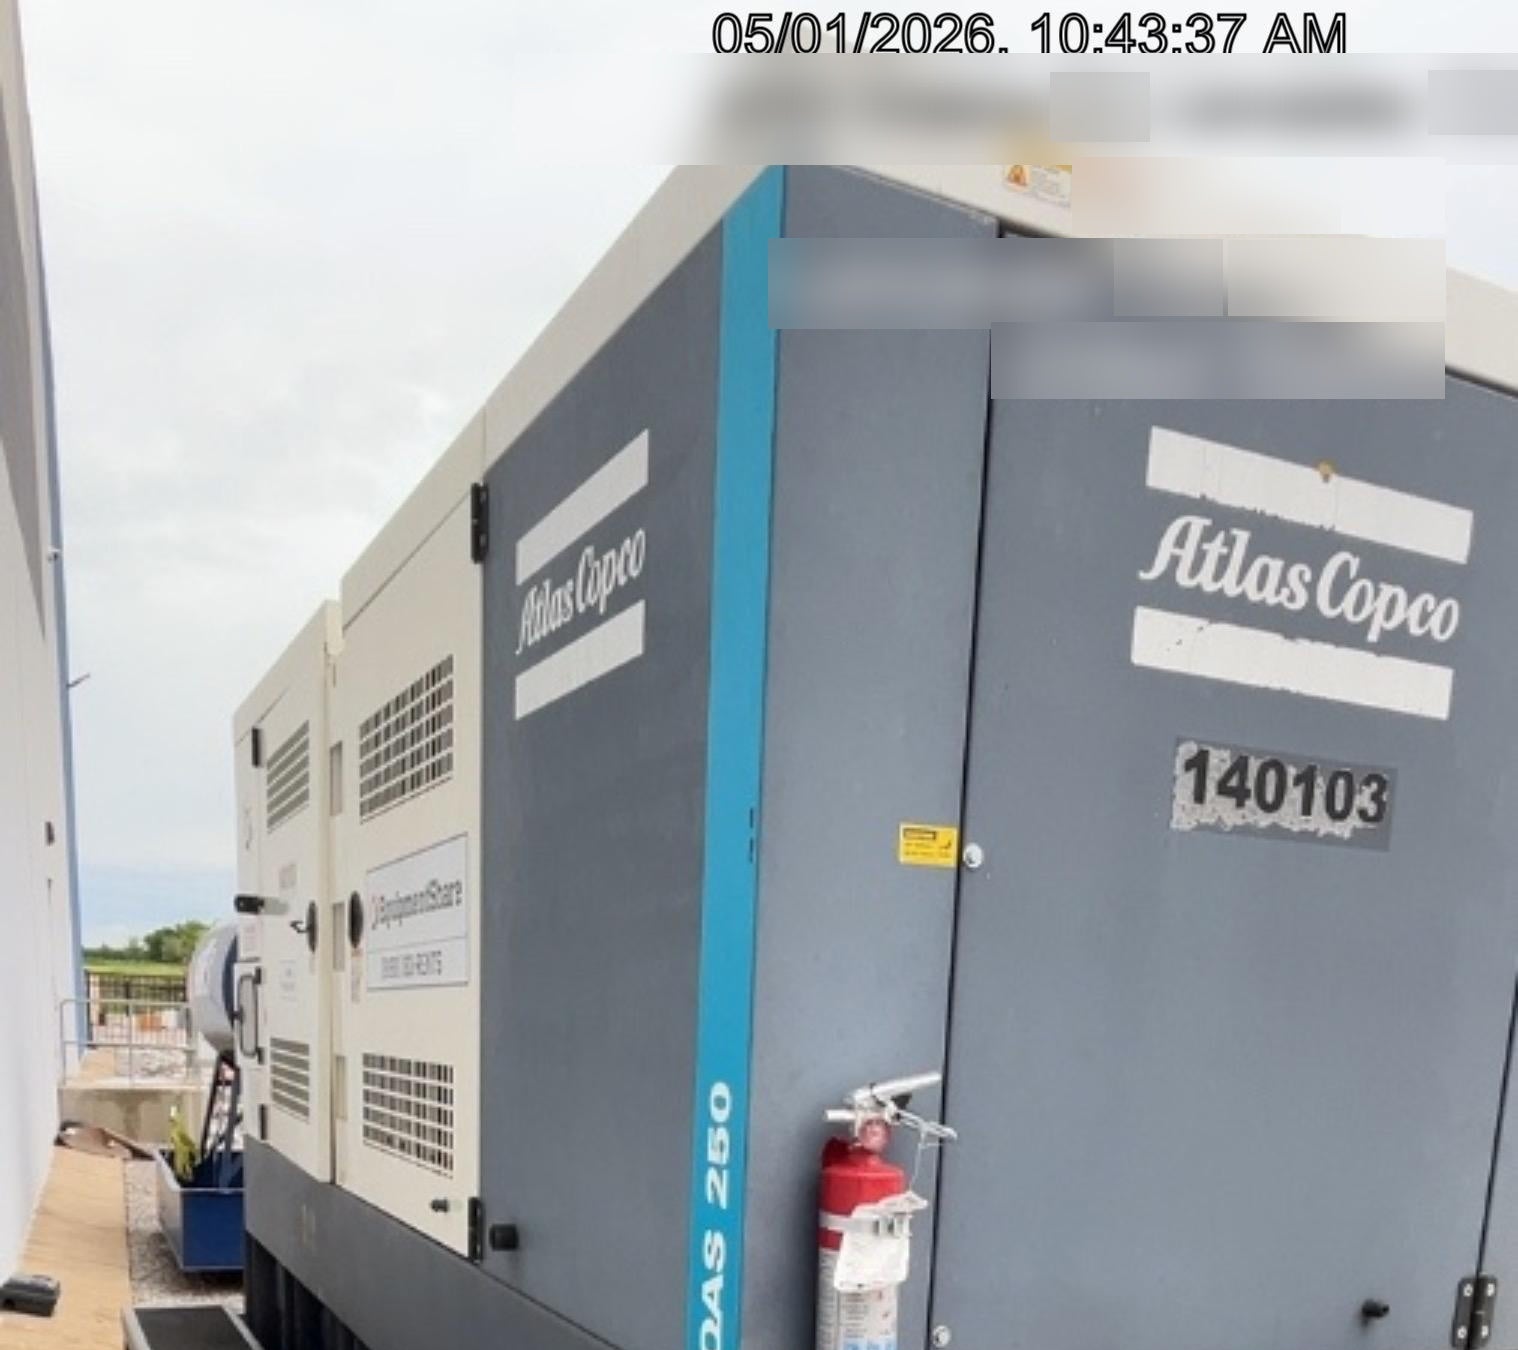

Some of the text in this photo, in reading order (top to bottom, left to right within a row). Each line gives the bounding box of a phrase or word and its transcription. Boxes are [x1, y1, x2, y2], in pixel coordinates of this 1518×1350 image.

[515, 528, 646, 656] Atlas Copco
[1138, 515, 1460, 643] Atlas Copco
[1183, 748, 1389, 824] 140103
[706, 1082, 731, 1210] 250
